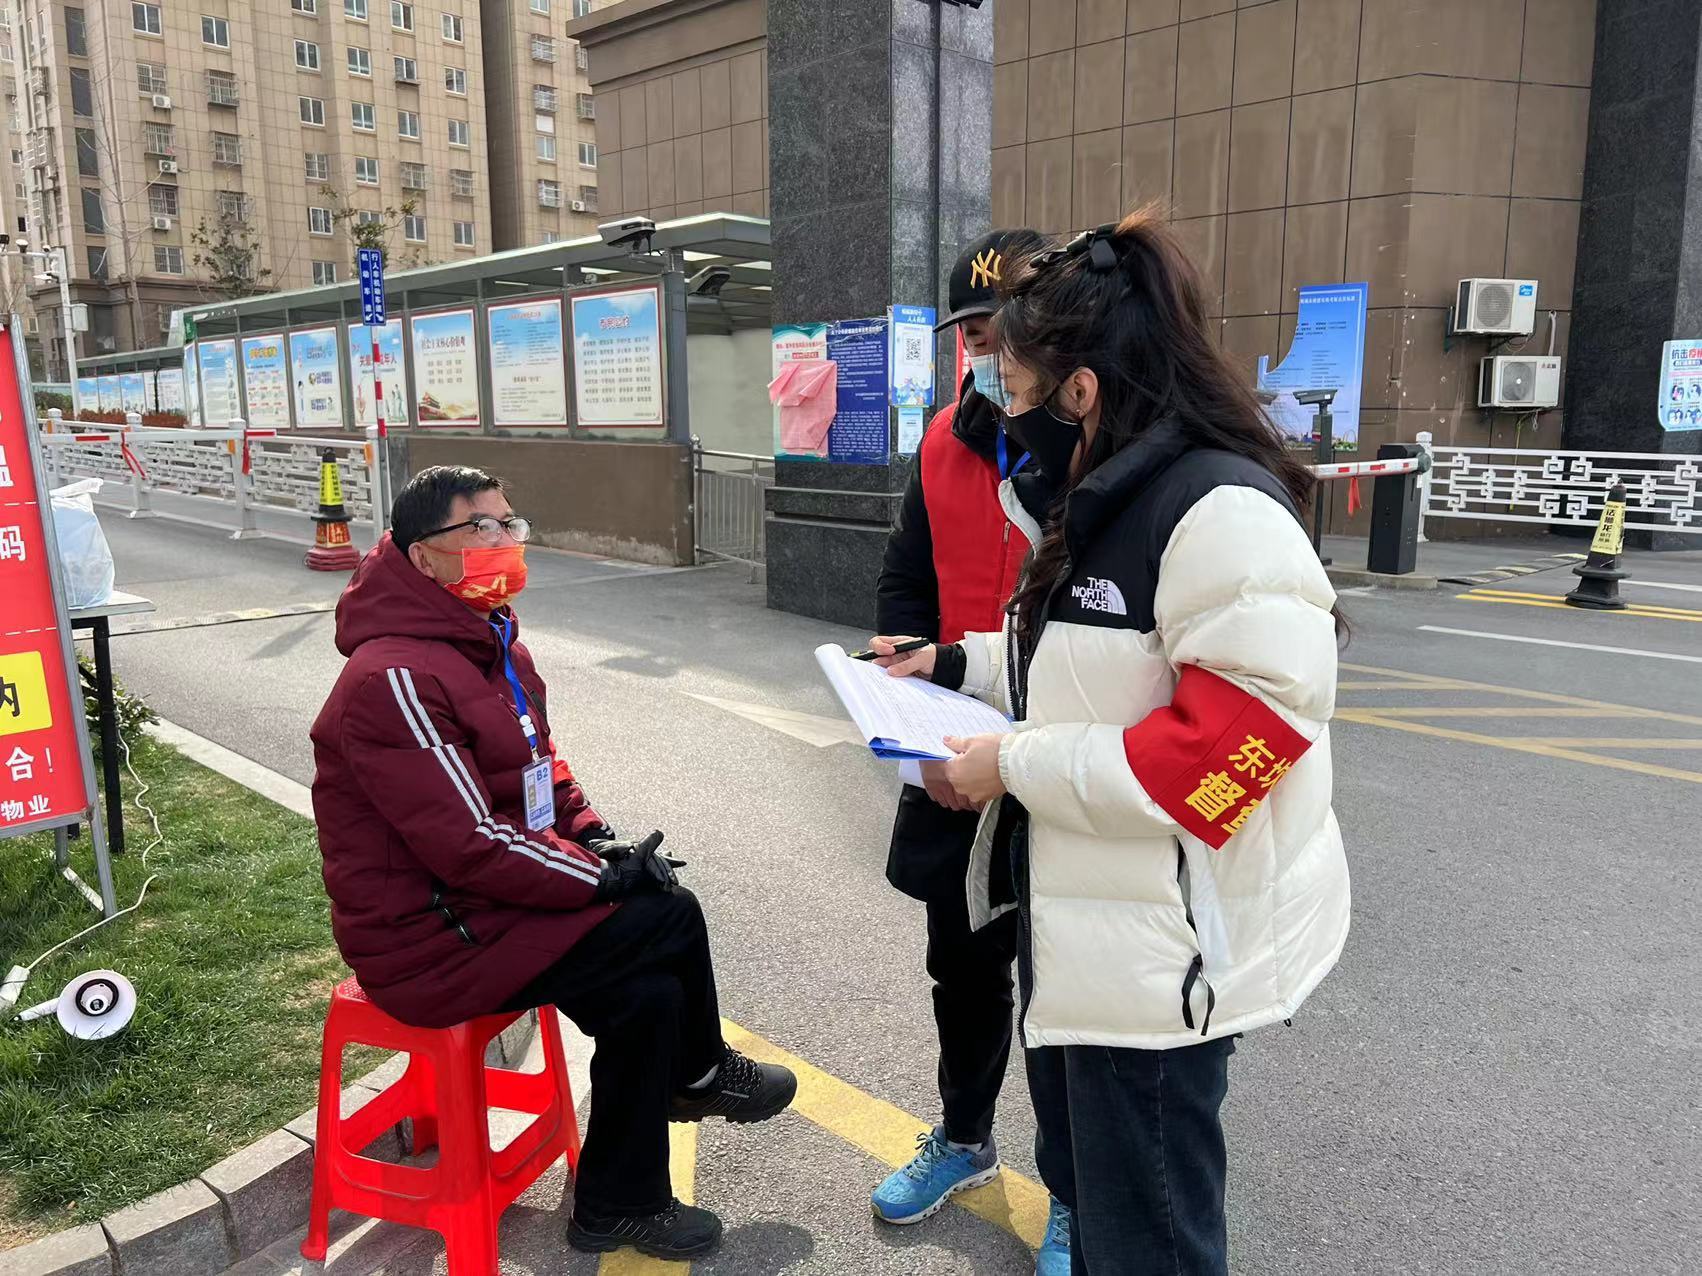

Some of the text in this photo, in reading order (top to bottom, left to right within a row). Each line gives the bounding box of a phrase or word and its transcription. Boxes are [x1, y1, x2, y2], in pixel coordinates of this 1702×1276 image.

[970, 247, 1002, 289] NY
[0, 525, 26, 562] 码
[1086, 576, 1108, 590] THE
[1071, 585, 1108, 601] NORTH
[1081, 598, 1108, 612] FACE
[536, 767, 548, 781] B2
[0, 794, 52, 822] 物业
